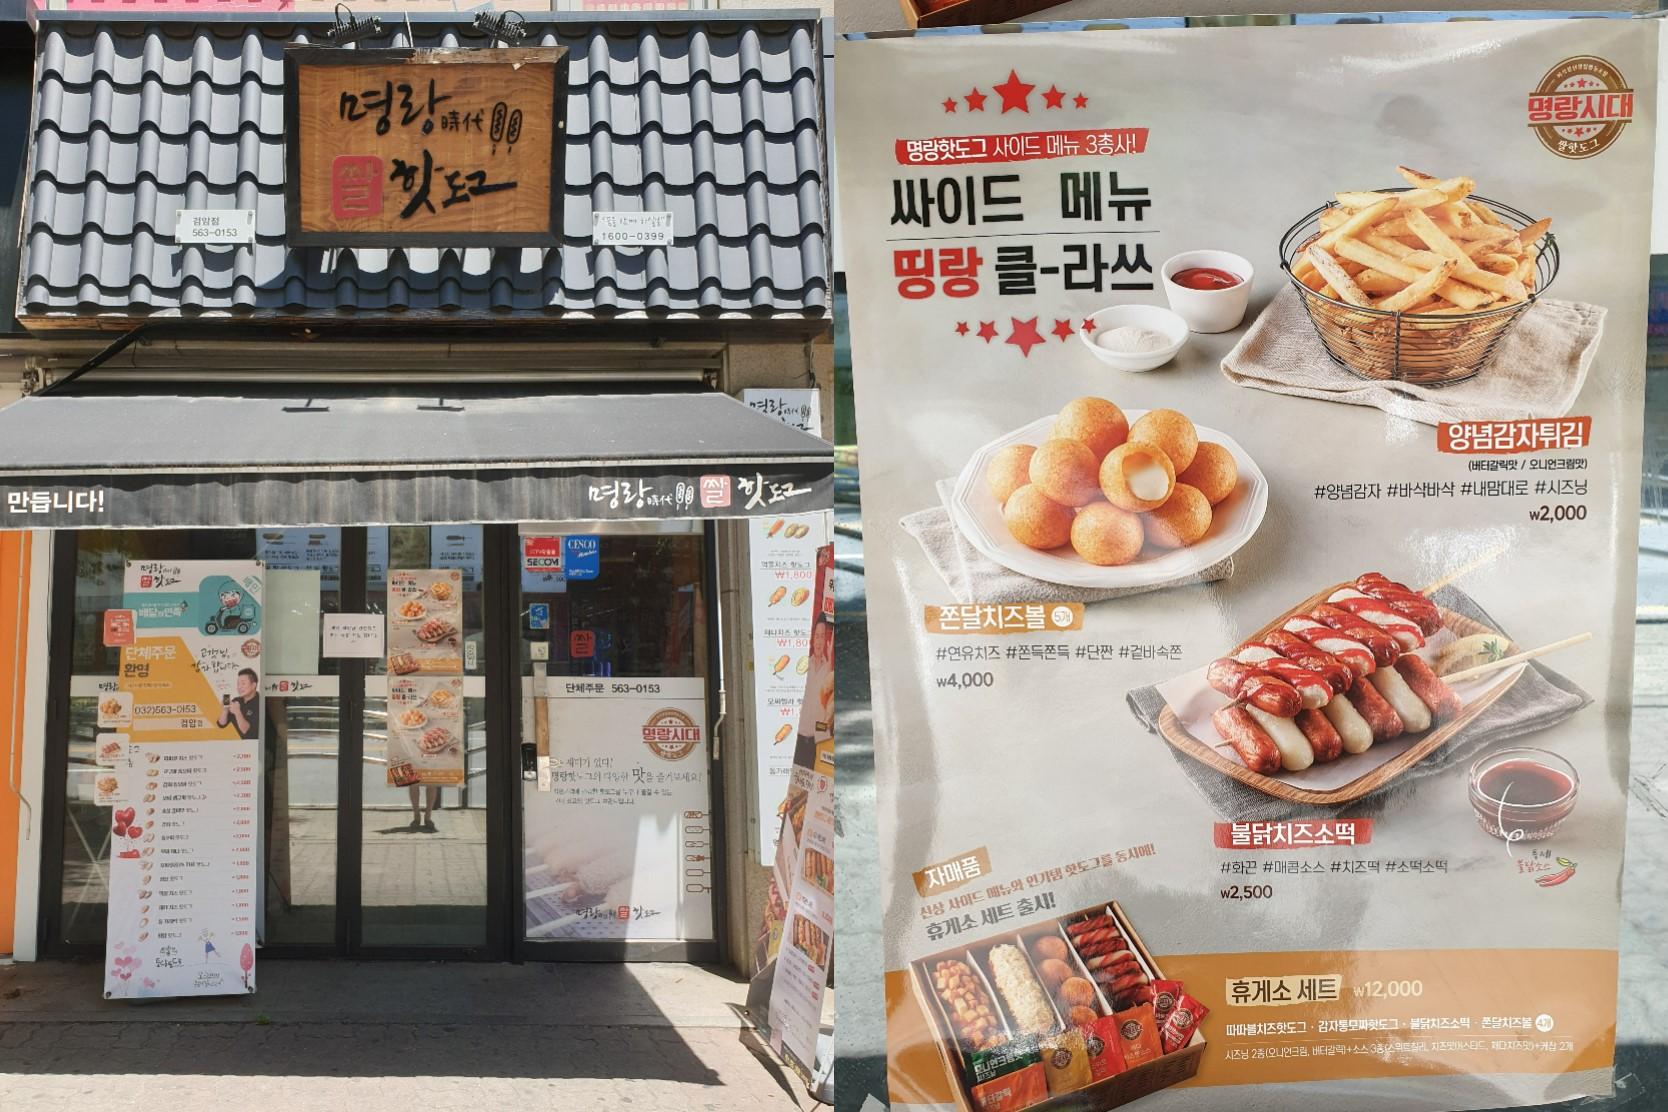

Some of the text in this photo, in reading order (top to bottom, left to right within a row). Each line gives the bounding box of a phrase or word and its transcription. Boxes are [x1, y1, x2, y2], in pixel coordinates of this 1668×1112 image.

[1528, 94, 1633, 122] 명랑시대
[907, 133, 1136, 162] 명랑핫도그 사이드 메뉴 3총사!
[891, 171, 1152, 227] 싸이드 메뉴
[193, 217, 220, 226] 검암점
[192, 229, 238, 237] 563-0153
[602, 232, 665, 241] 1600-0399
[893, 243, 1154, 300] 띵랑 클-라쓰
[1449, 422, 1584, 451] 양념감자튀김
[1468, 459, 1517, 472] (버터갈릭맛
[1314, 479, 1588, 500] #양념감자 #바삭바삭 #내맘대로 #시즈닝
[8, 490, 104, 513] 만듭니다!
[527, 558, 559, 566] SECOM
[939, 604, 1046, 630] 쫀달치즈볼
[125, 644, 176, 660] 단체주문
[936, 645, 1000, 661] #연유치즈
[1006, 644, 1070, 660] #쫀득쫀득
[1075, 645, 1113, 660] #단짠
[124, 663, 149, 678] 환영
[565, 683, 661, 694] 단체주문 563-0153
[134, 704, 197, 716] 032)563-0153
[642, 727, 700, 741] 명랑시대
[1231, 822, 1355, 846] 불닭치즈소떡
[925, 855, 981, 888] 자매품
[1220, 860, 1448, 875] #화끈 #매콤소스 #치즈떡 #소떡소떡
[920, 903, 945, 919] 신상
[949, 891, 985, 911] 사이드
[987, 878, 1025, 899] 메뉴와
[926, 891, 1057, 941] 휴게소 세트 출시!
[1231, 981, 1292, 1006] 휴게소
[1297, 979, 1338, 1001] 세트
[1410, 1017, 1471, 1030] 불닭치즈소떡
[1481, 1017, 1534, 1029] 쫀달치즈볼
[1225, 1049, 1249, 1060] 시즈닝
